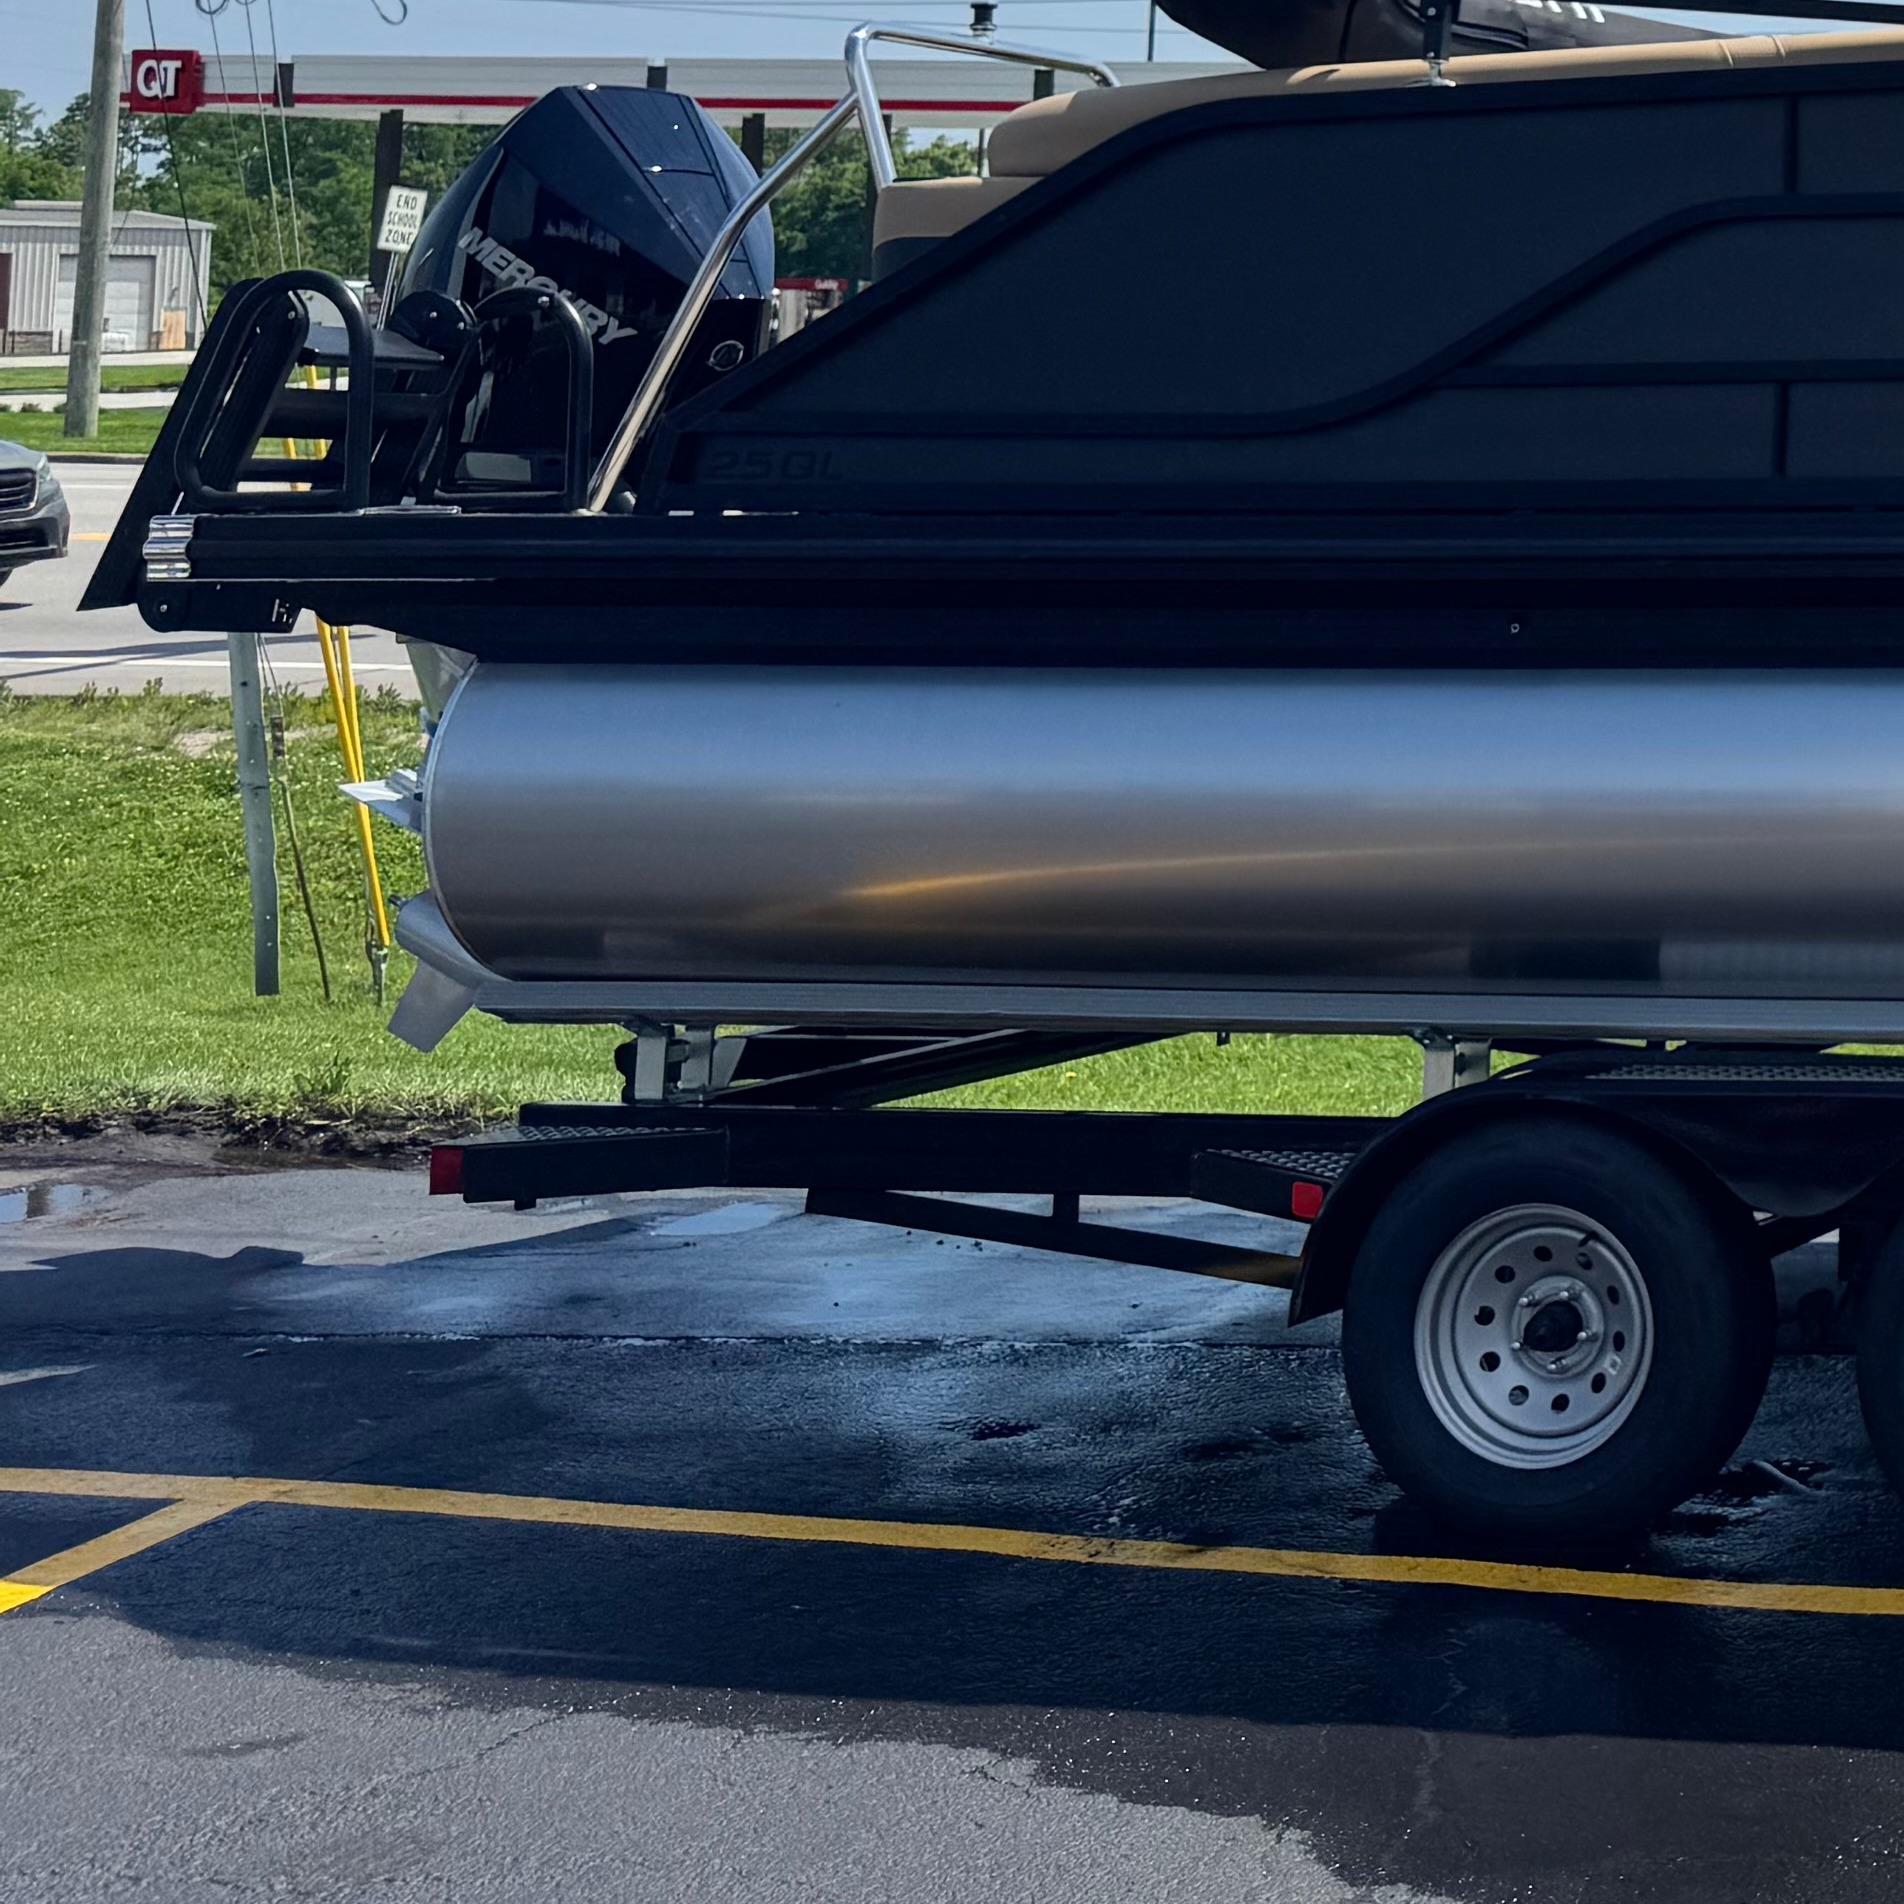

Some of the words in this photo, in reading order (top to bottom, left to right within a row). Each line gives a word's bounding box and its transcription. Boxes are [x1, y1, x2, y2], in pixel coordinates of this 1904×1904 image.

[137, 59, 182, 99] QT
[397, 194, 417, 210] END
[388, 212, 417, 229] SCHOOL
[385, 229, 413, 245] ZONE
